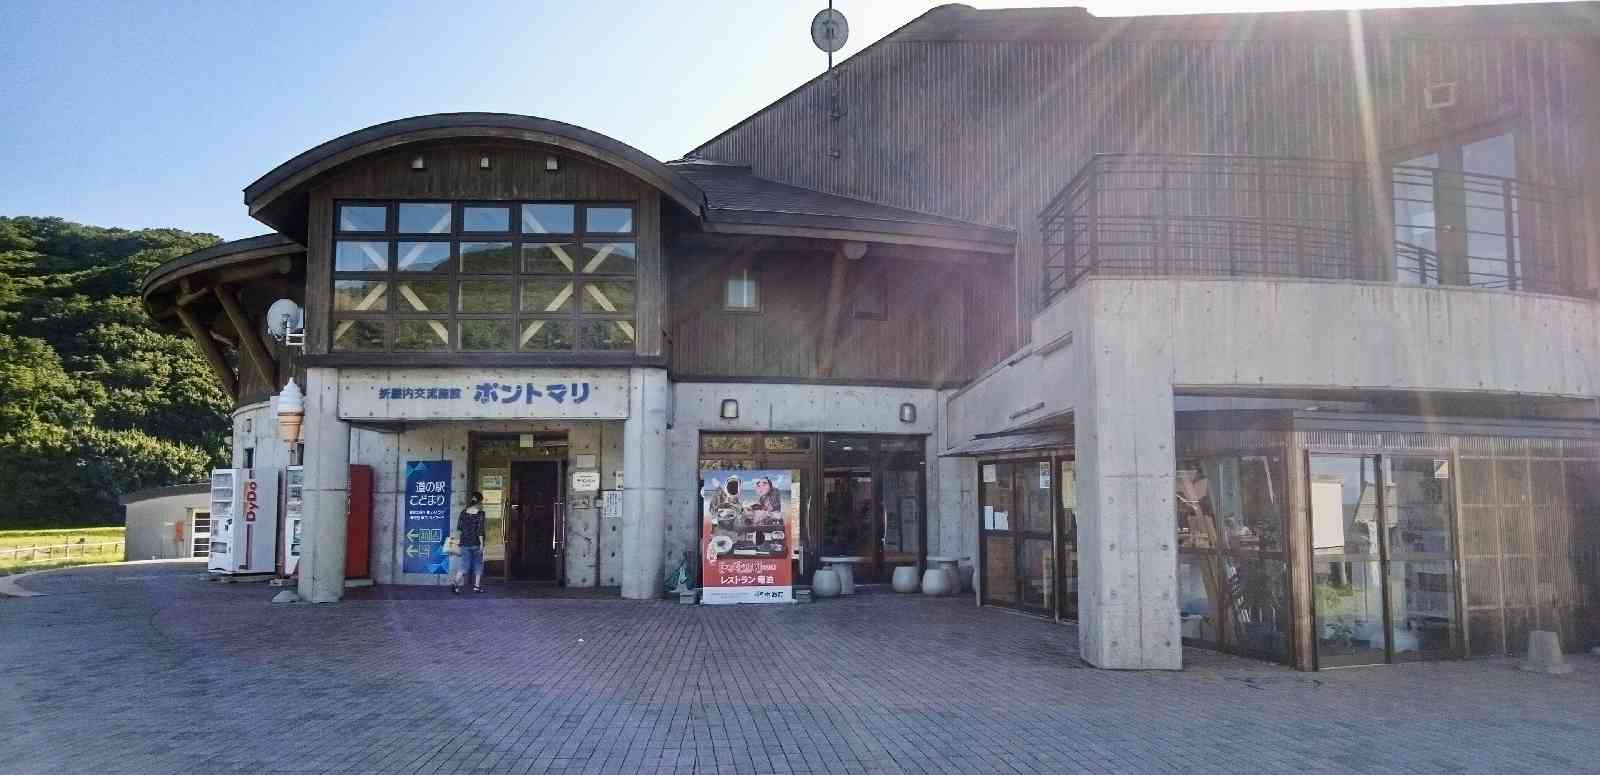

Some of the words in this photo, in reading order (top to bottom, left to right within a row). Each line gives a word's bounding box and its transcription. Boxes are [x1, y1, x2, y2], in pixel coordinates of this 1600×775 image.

[474, 382, 589, 404] ポントマリ
[415, 481, 446, 493] 道の駅
[246, 481, 258, 522] DyDo
[409, 495, 445, 506] こどまり
[720, 575, 756, 585] レストラン
